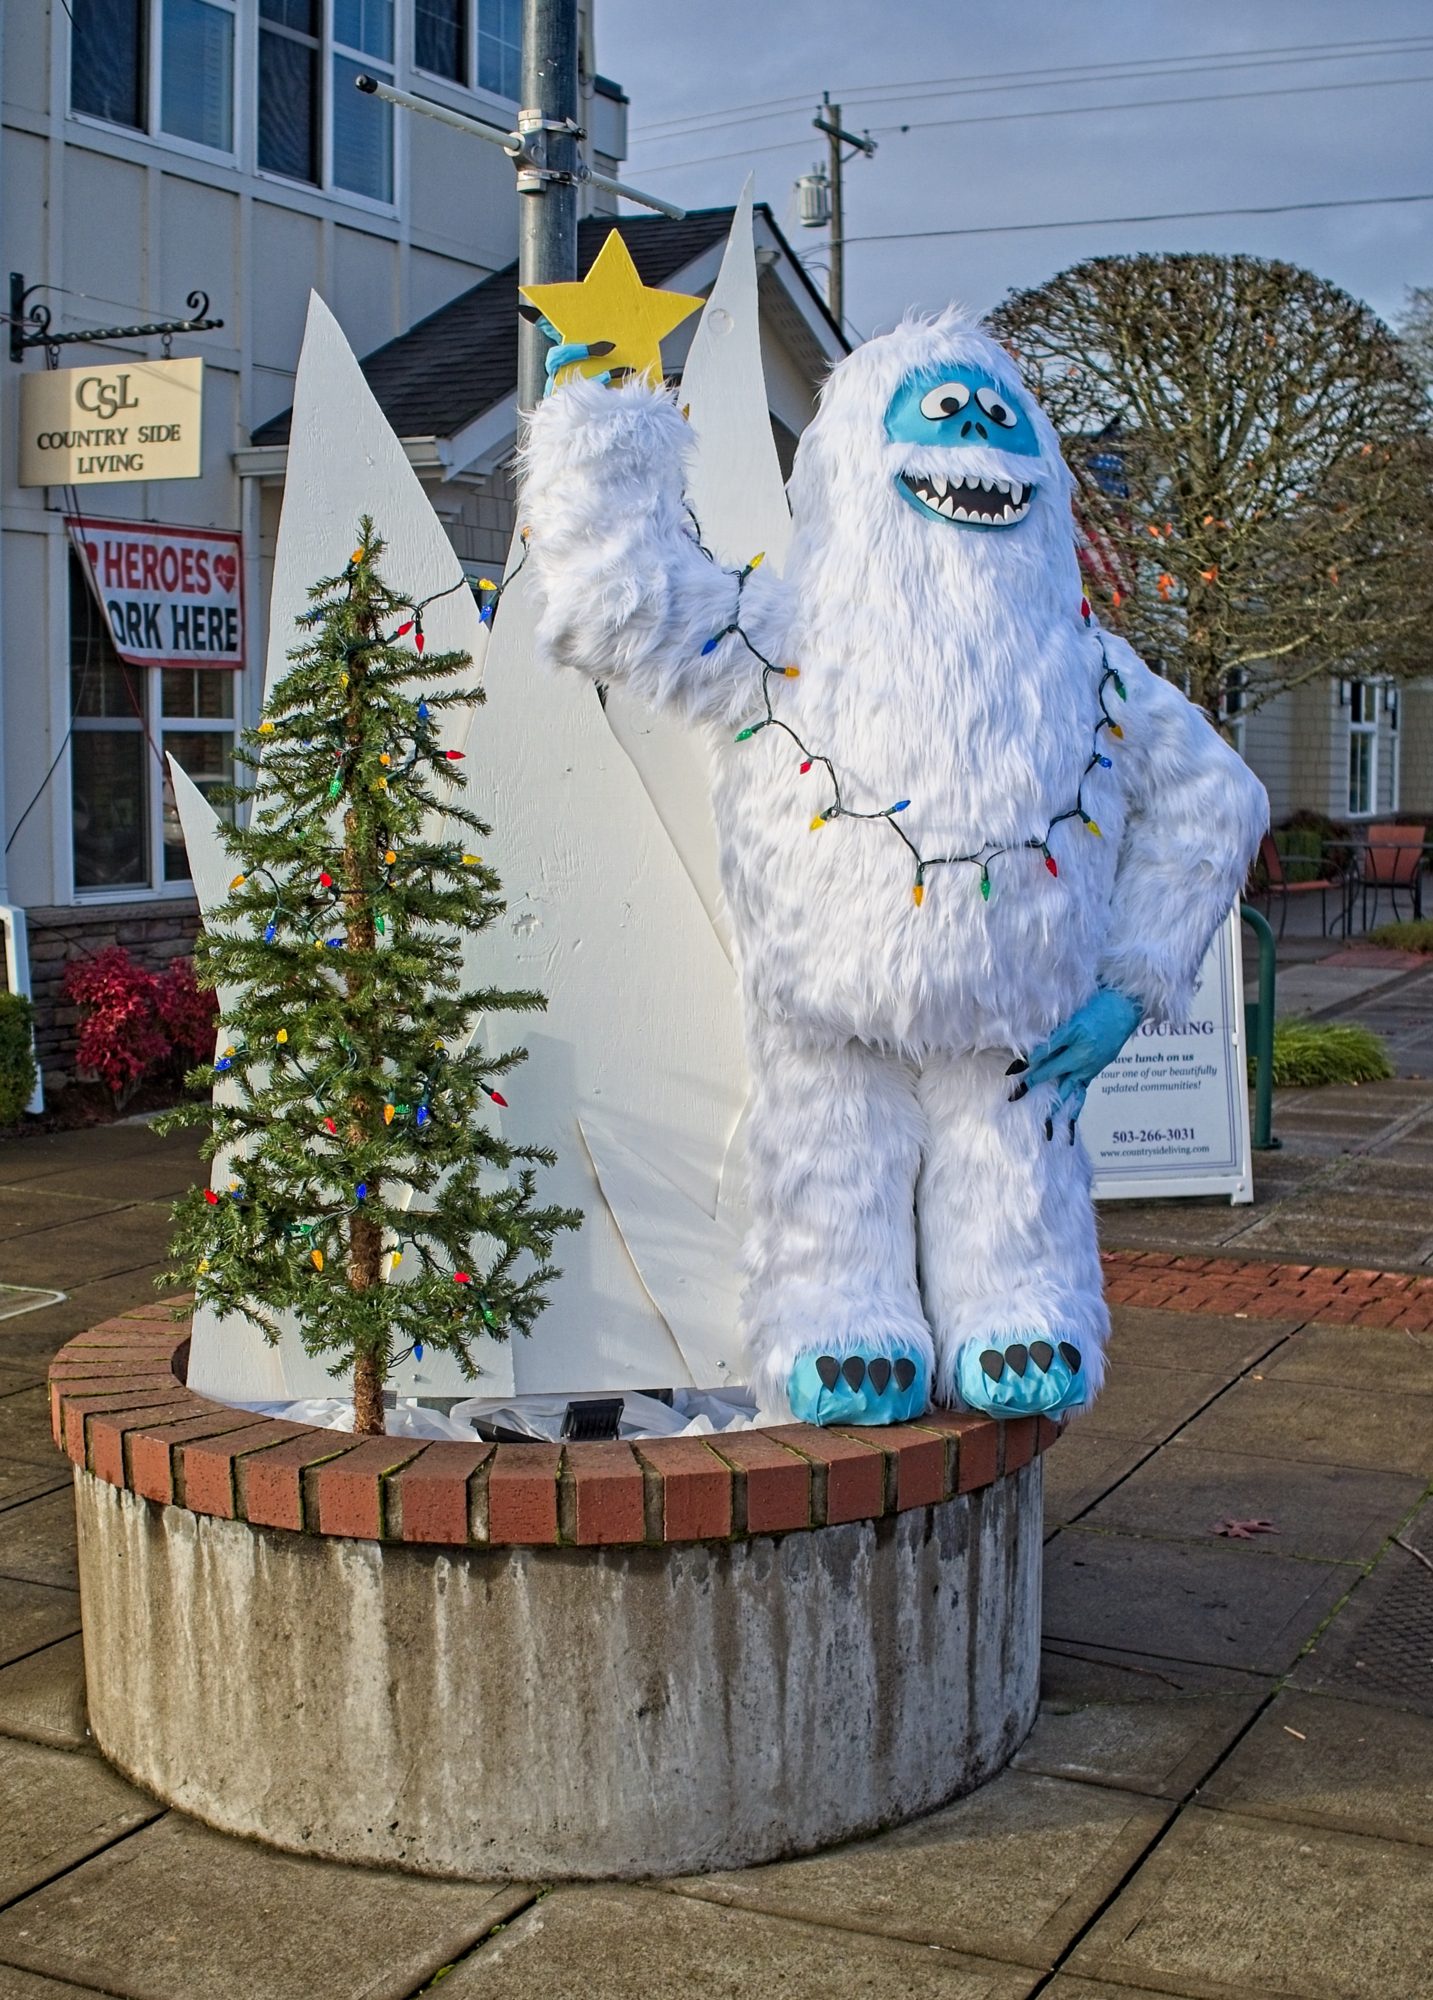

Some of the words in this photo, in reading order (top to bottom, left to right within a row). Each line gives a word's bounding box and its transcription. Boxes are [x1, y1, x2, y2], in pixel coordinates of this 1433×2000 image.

[76, 374, 139, 420] CSL
[37, 428, 128, 450] COUNTRY
[138, 424, 181, 444] SIDE
[77, 454, 144, 474] LIVING
[104, 541, 211, 595] HEROES
[106, 600, 163, 649] ORK
[170, 604, 238, 652] HERE
[1135, 1053, 1164, 1063] lunch
[1101, 1070, 1120, 1079] tour
[1122, 1070, 1139, 1078] one
[1140, 1066, 1150, 1079] of
[1151, 1069, 1167, 1077] our
[1169, 1065, 1217, 1077] beautifully
[1102, 1082, 1138, 1095] updated
[1140, 1081, 1201, 1092] communities!
[1112, 1128, 1195, 1143] 503-266-3031
[1100, 1145, 1210, 1157] www.countrysideliving.com
